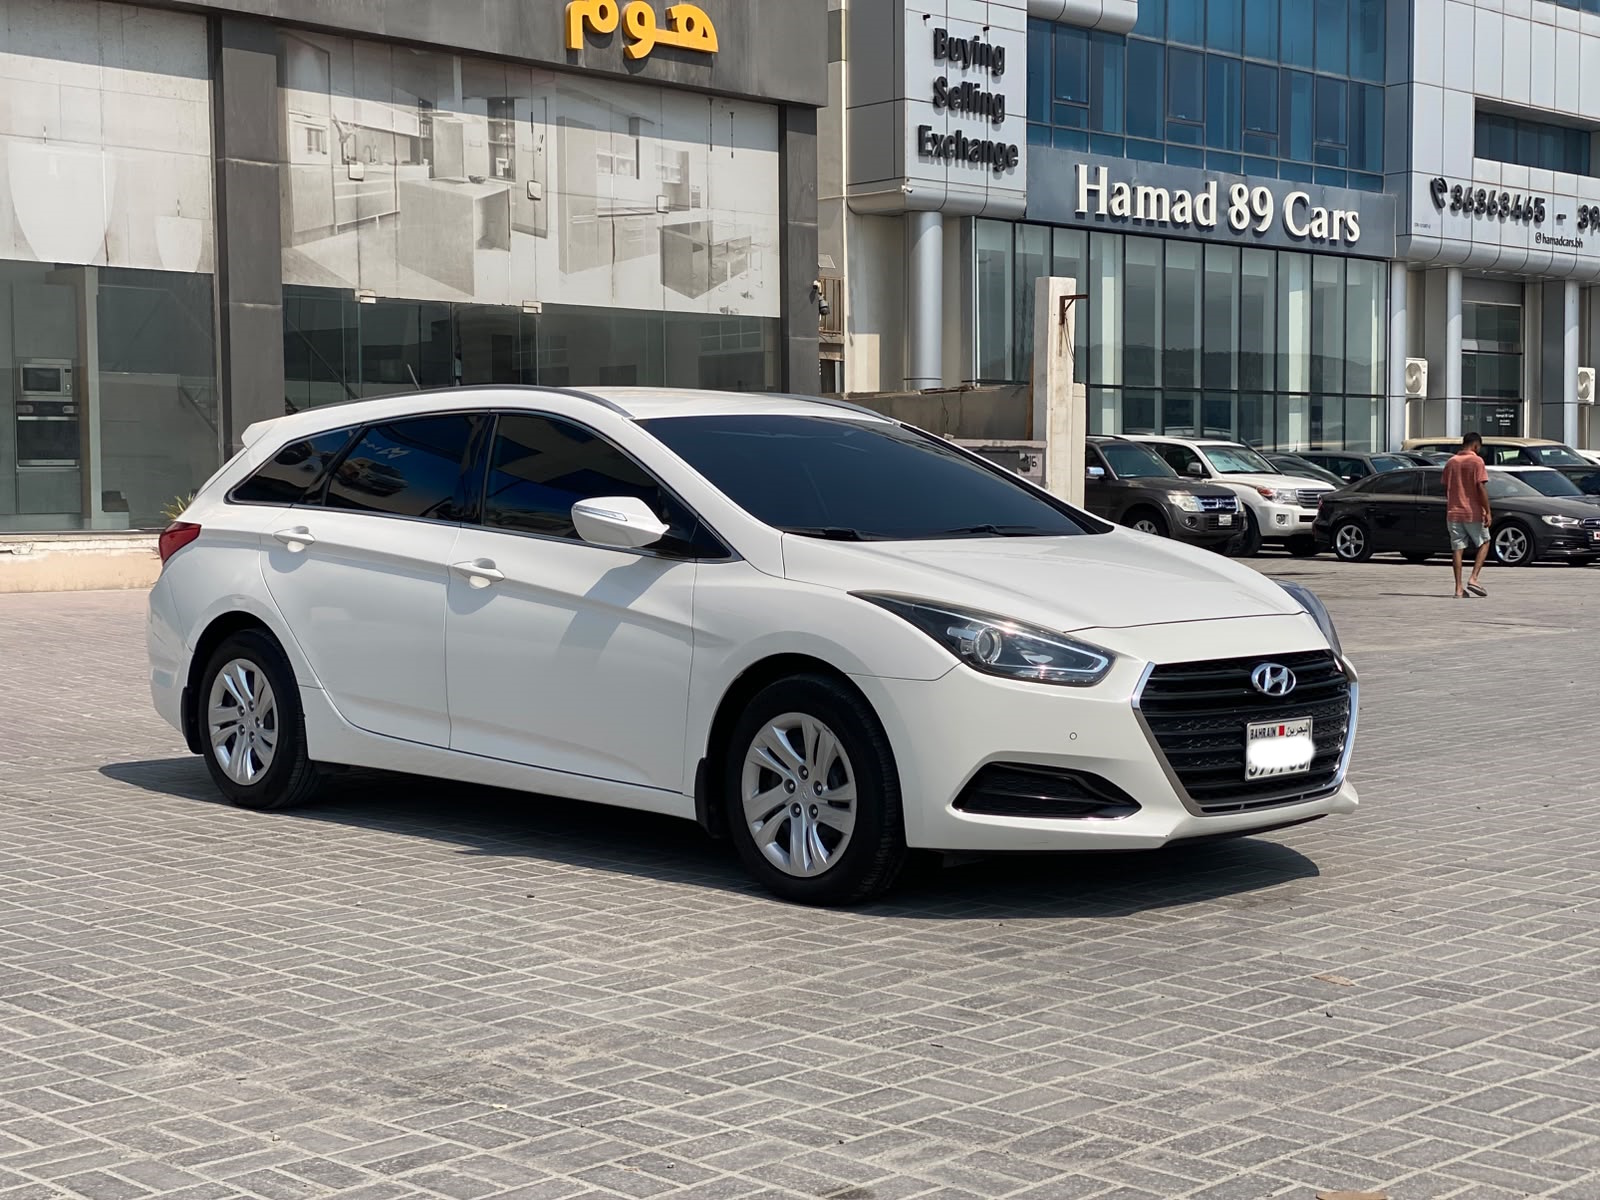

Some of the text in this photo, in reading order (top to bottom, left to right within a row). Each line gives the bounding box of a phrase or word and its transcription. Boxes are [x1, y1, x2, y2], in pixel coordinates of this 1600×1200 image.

[565, 0, 719, 59] هوم
[933, 27, 1005, 76] Buying
[933, 76, 1005, 124] Selling
[918, 125, 1019, 172] Exchange
[1075, 164, 1360, 242] Hamad 89 Cars
[1450, 184, 1546, 223] 36363465
[1577, 204, 1600, 231] 39
[1250, 727, 1277, 740] BAHRAIN
